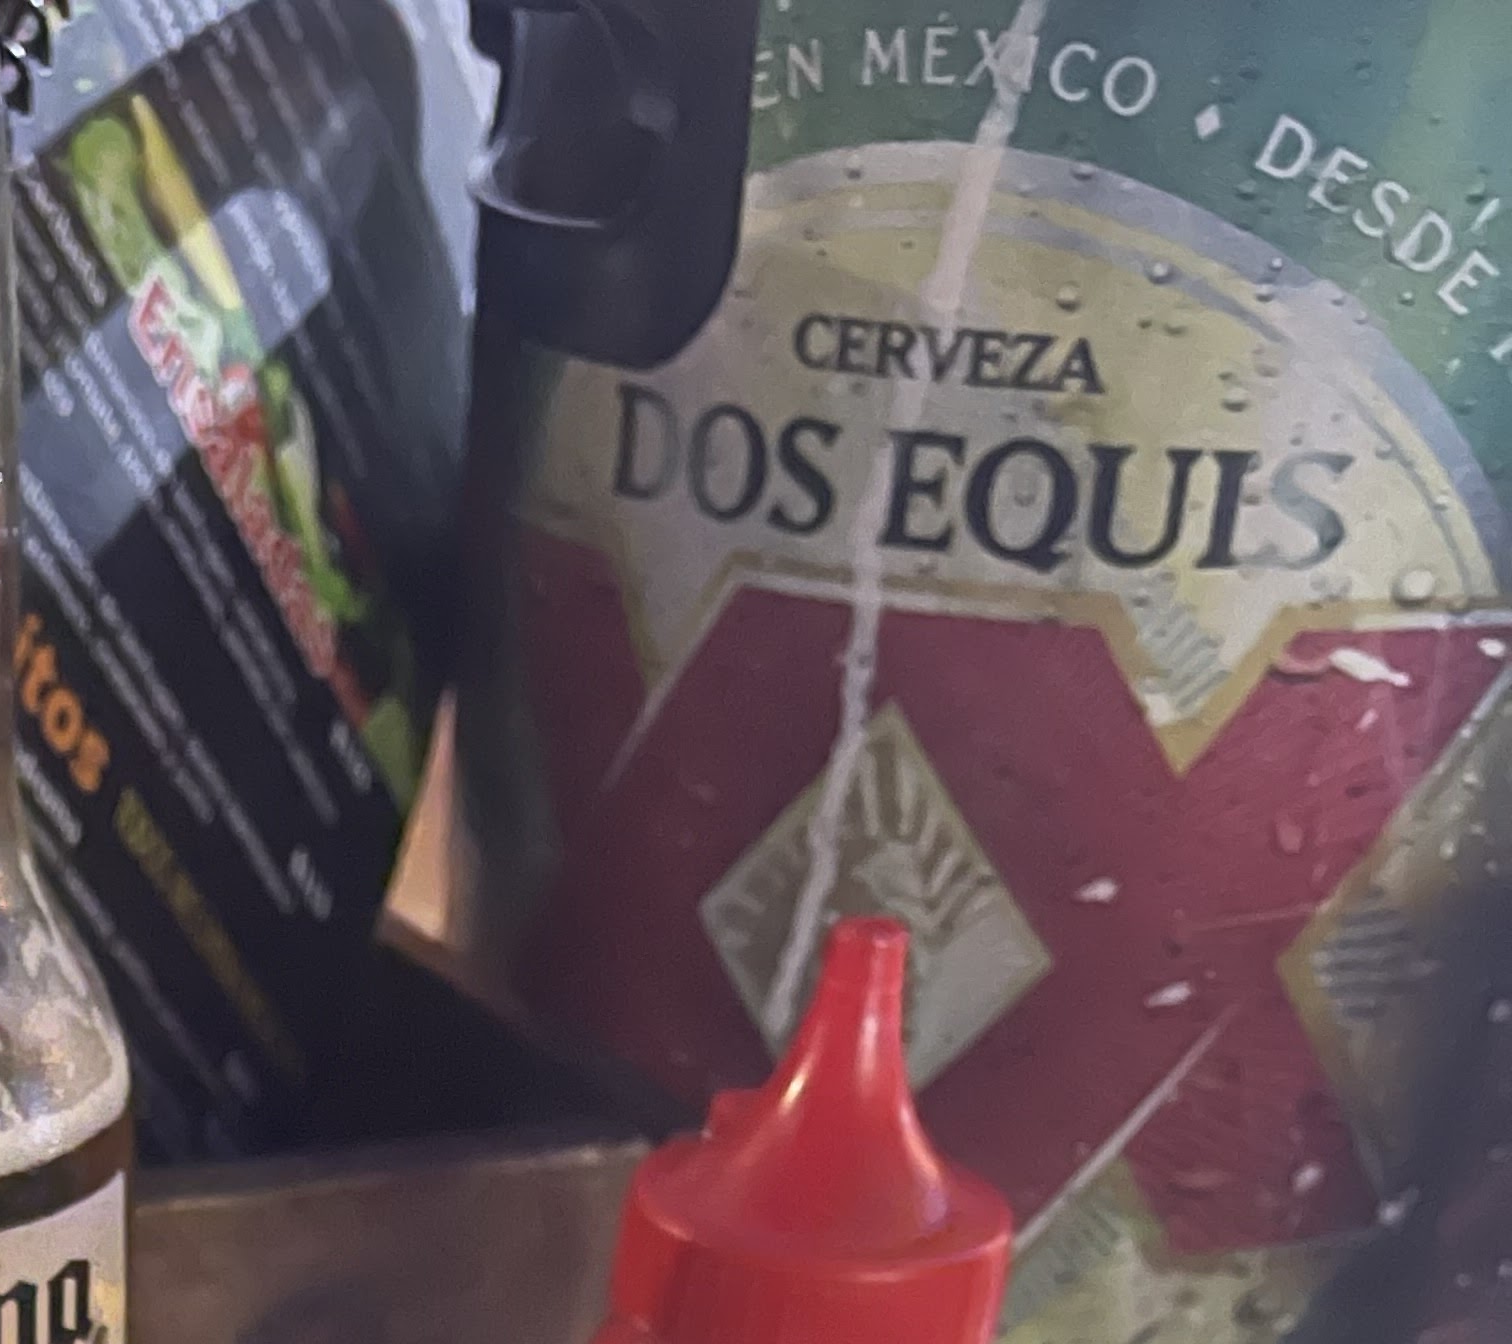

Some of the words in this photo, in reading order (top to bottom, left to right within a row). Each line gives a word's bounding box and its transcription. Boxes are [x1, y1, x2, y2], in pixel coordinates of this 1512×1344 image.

[1255, 114, 1501, 316] DESDE
[791, 311, 1108, 395] CERVEZA
[612, 383, 844, 536] DOS
[876, 428, 1357, 576] EQUIS
